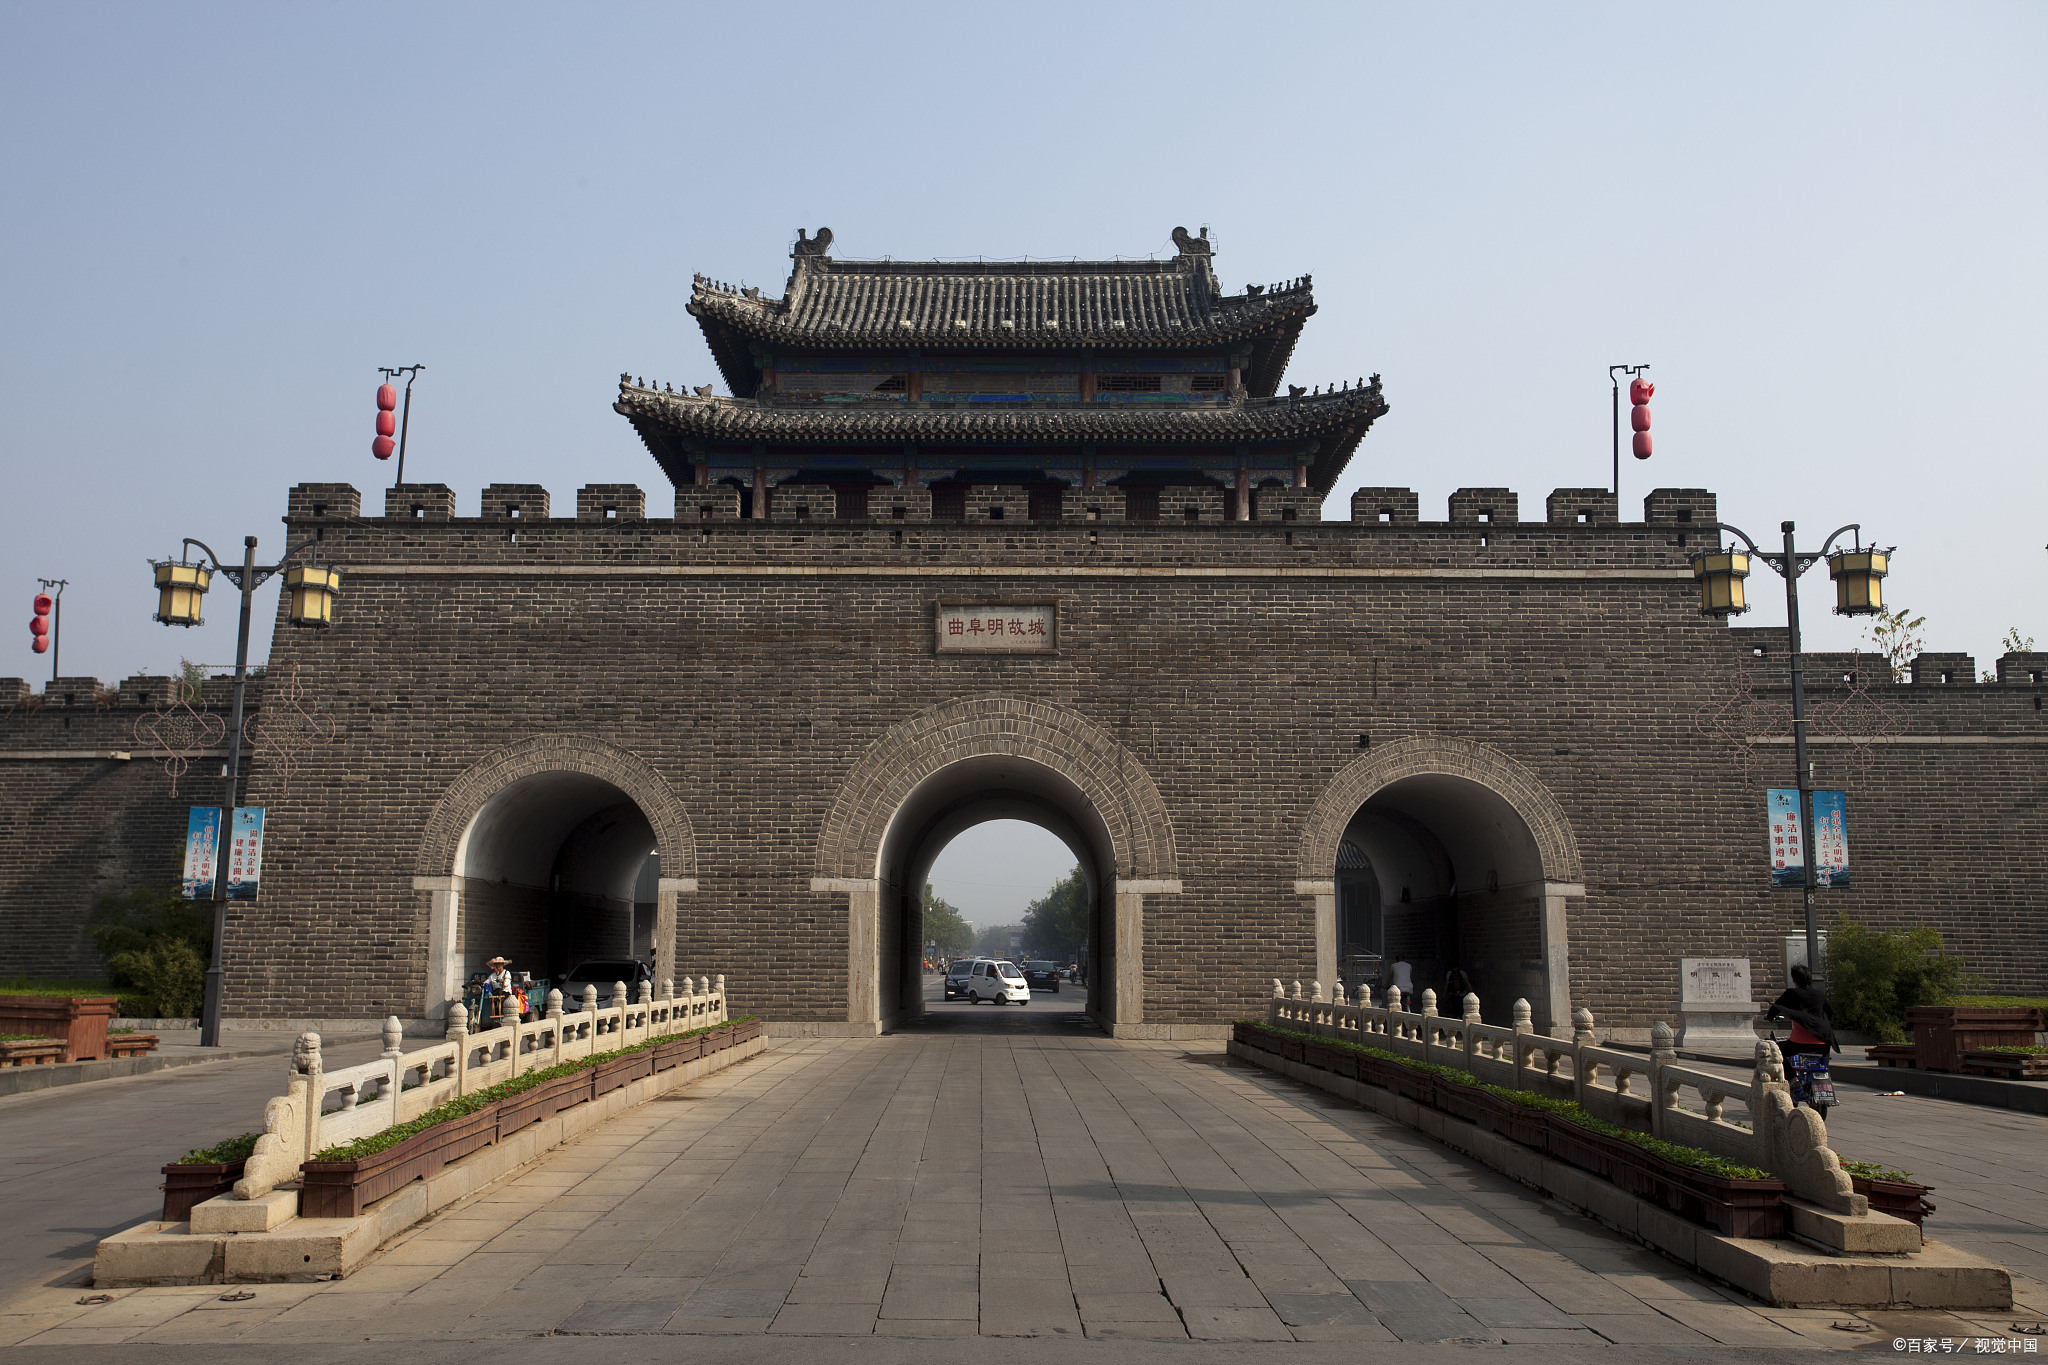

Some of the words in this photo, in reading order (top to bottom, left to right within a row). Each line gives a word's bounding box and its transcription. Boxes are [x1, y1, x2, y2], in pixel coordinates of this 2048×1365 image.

[948, 617, 1047, 636] 曲阜明故城
[200, 825, 214, 884] 创建全国文明城市
[1773, 824, 1785, 869] 事事遵廉
[1786, 812, 1799, 857] 廉洁曲阜
[1820, 816, 1831, 884] 打造美丽宜居曲阜
[1831, 810, 1843, 871] 创建全国文明城市
[232, 838, 244, 885] 建廉洁曲阜
